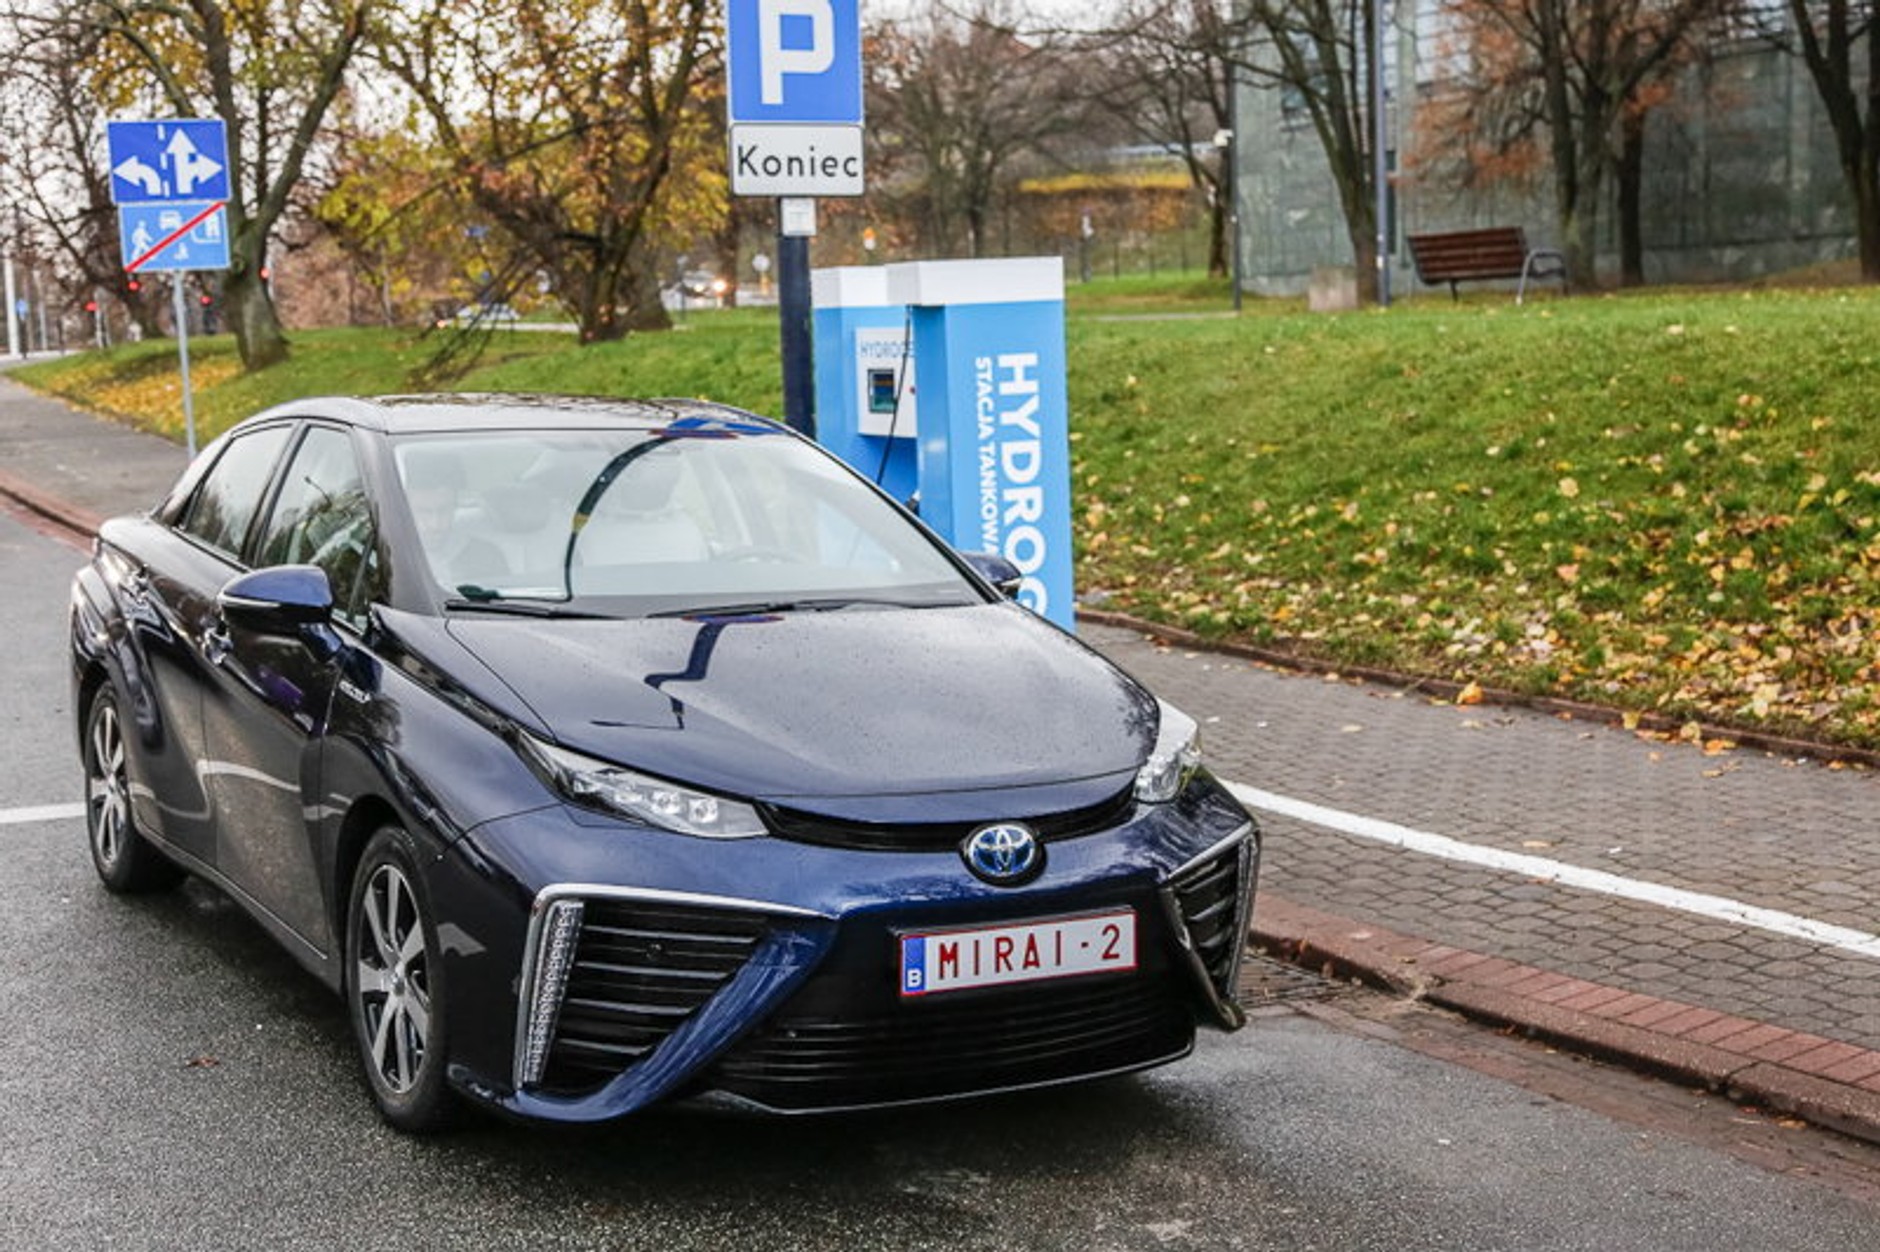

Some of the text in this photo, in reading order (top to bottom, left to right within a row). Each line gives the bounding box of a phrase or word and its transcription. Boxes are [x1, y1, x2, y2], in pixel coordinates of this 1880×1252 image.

[759, 0, 834, 104] P
[738, 145, 858, 177] Koniec
[976, 357, 995, 440] STACJA
[907, 970, 922, 987] B
